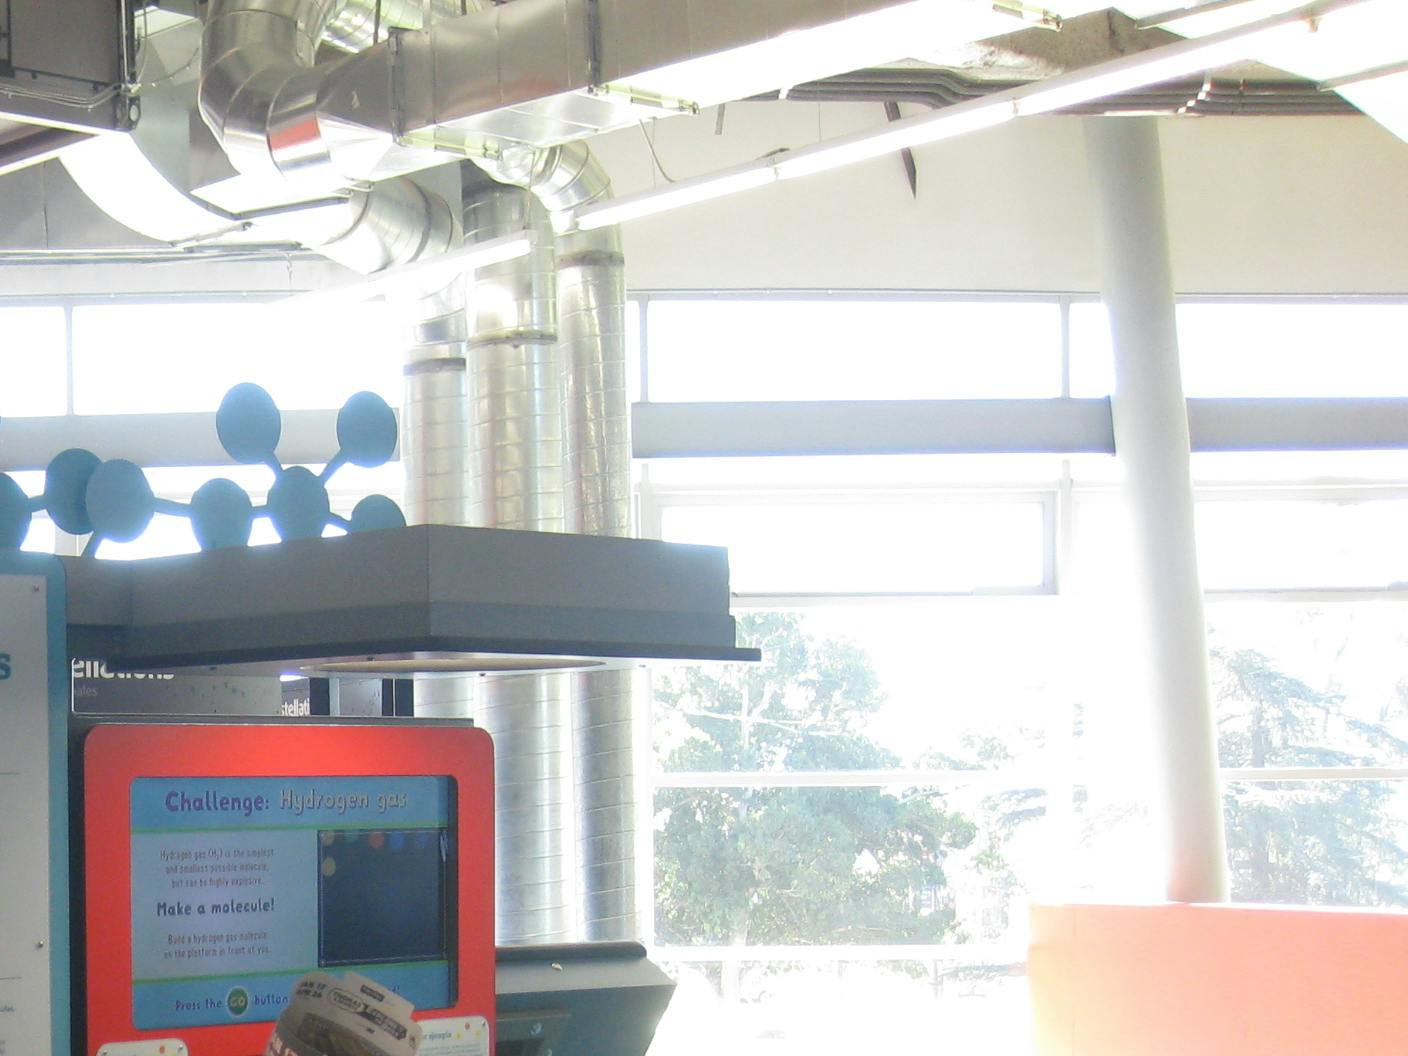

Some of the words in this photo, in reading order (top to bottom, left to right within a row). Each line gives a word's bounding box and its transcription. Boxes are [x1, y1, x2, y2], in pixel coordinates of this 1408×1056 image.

[165, 791, 269, 816] Challenge:
[279, 789, 369, 816] Hydrogen
[377, 792, 408, 815] gas
[160, 849, 193, 863] Hydrogen
[156, 901, 192, 917] Make
[197, 904, 206, 915] a
[211, 898, 275, 914] molecule!
[175, 999, 201, 1012] Press
[205, 997, 223, 1010] the
[228, 995, 246, 1008] GO
[254, 992, 288, 1006] button
